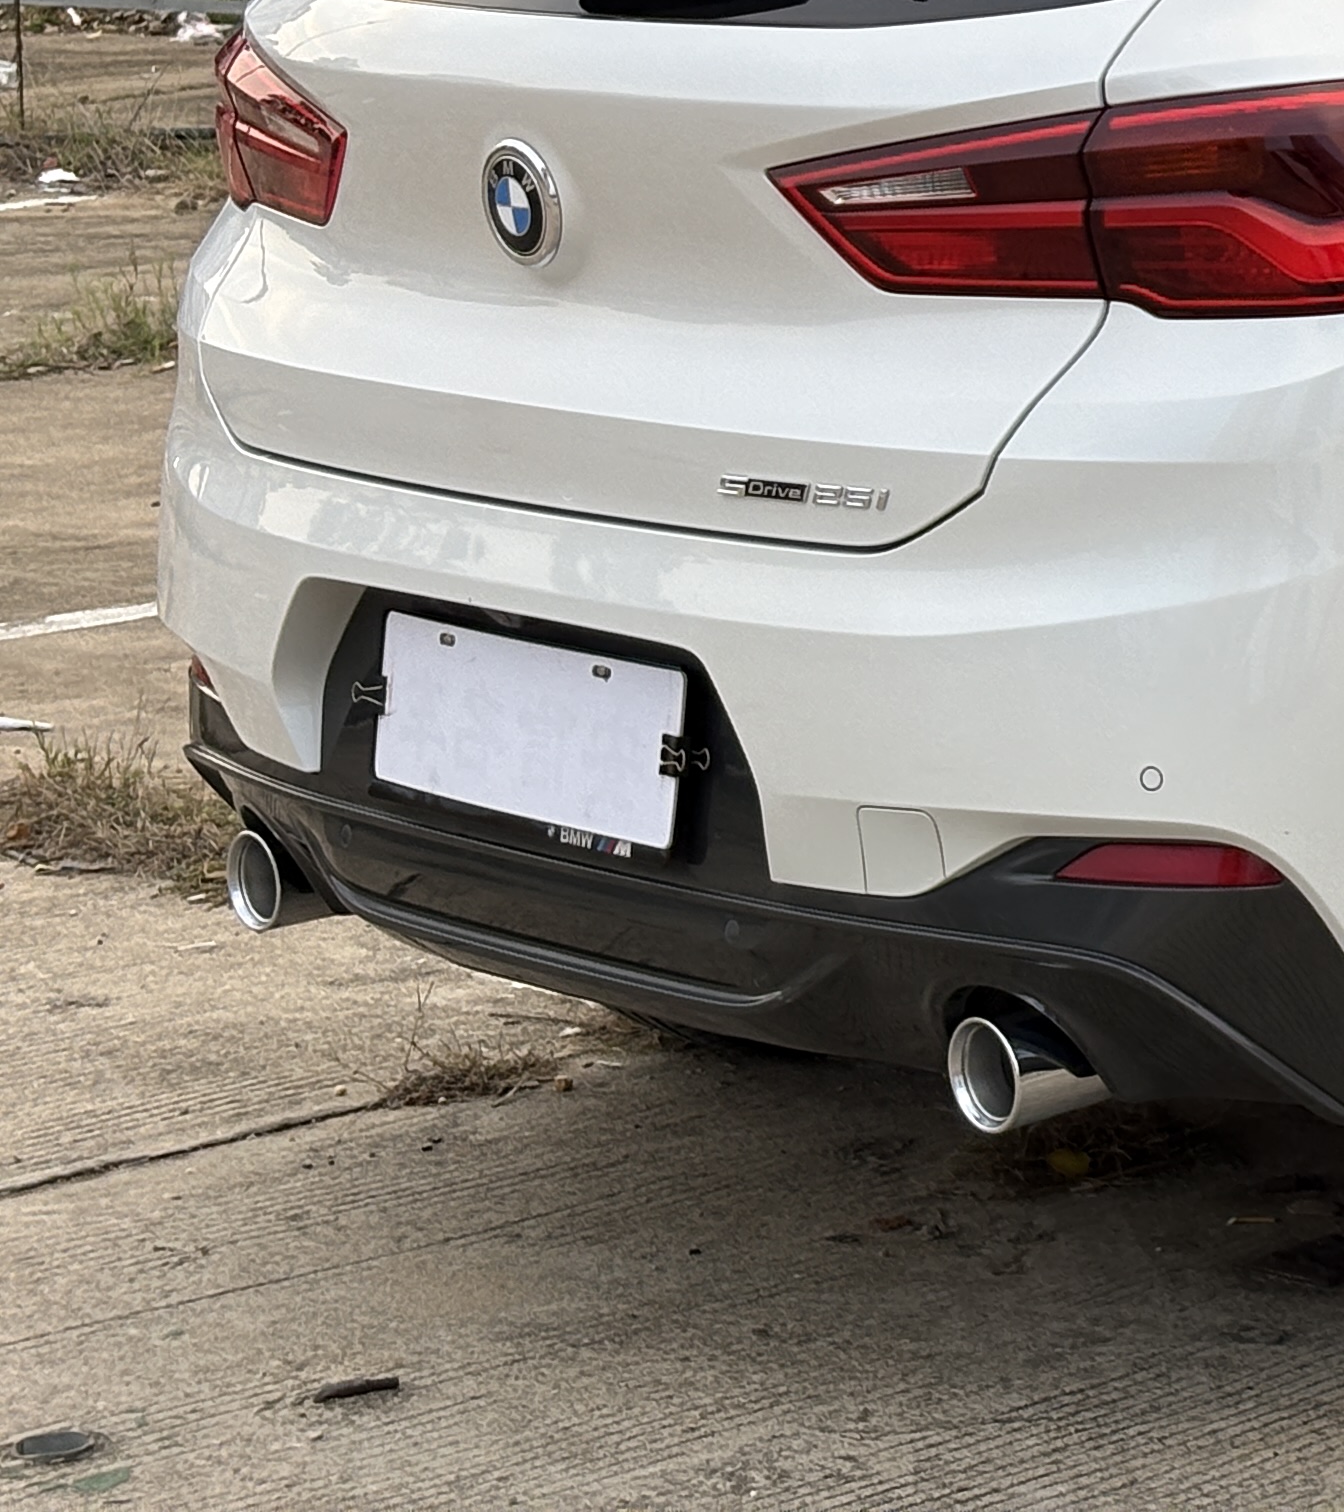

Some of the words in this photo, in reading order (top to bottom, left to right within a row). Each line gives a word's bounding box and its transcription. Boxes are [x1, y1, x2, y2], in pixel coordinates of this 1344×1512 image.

[489, 160, 536, 193] BMW
[813, 482, 889, 511] 25i
[560, 826, 594, 849] BMW
